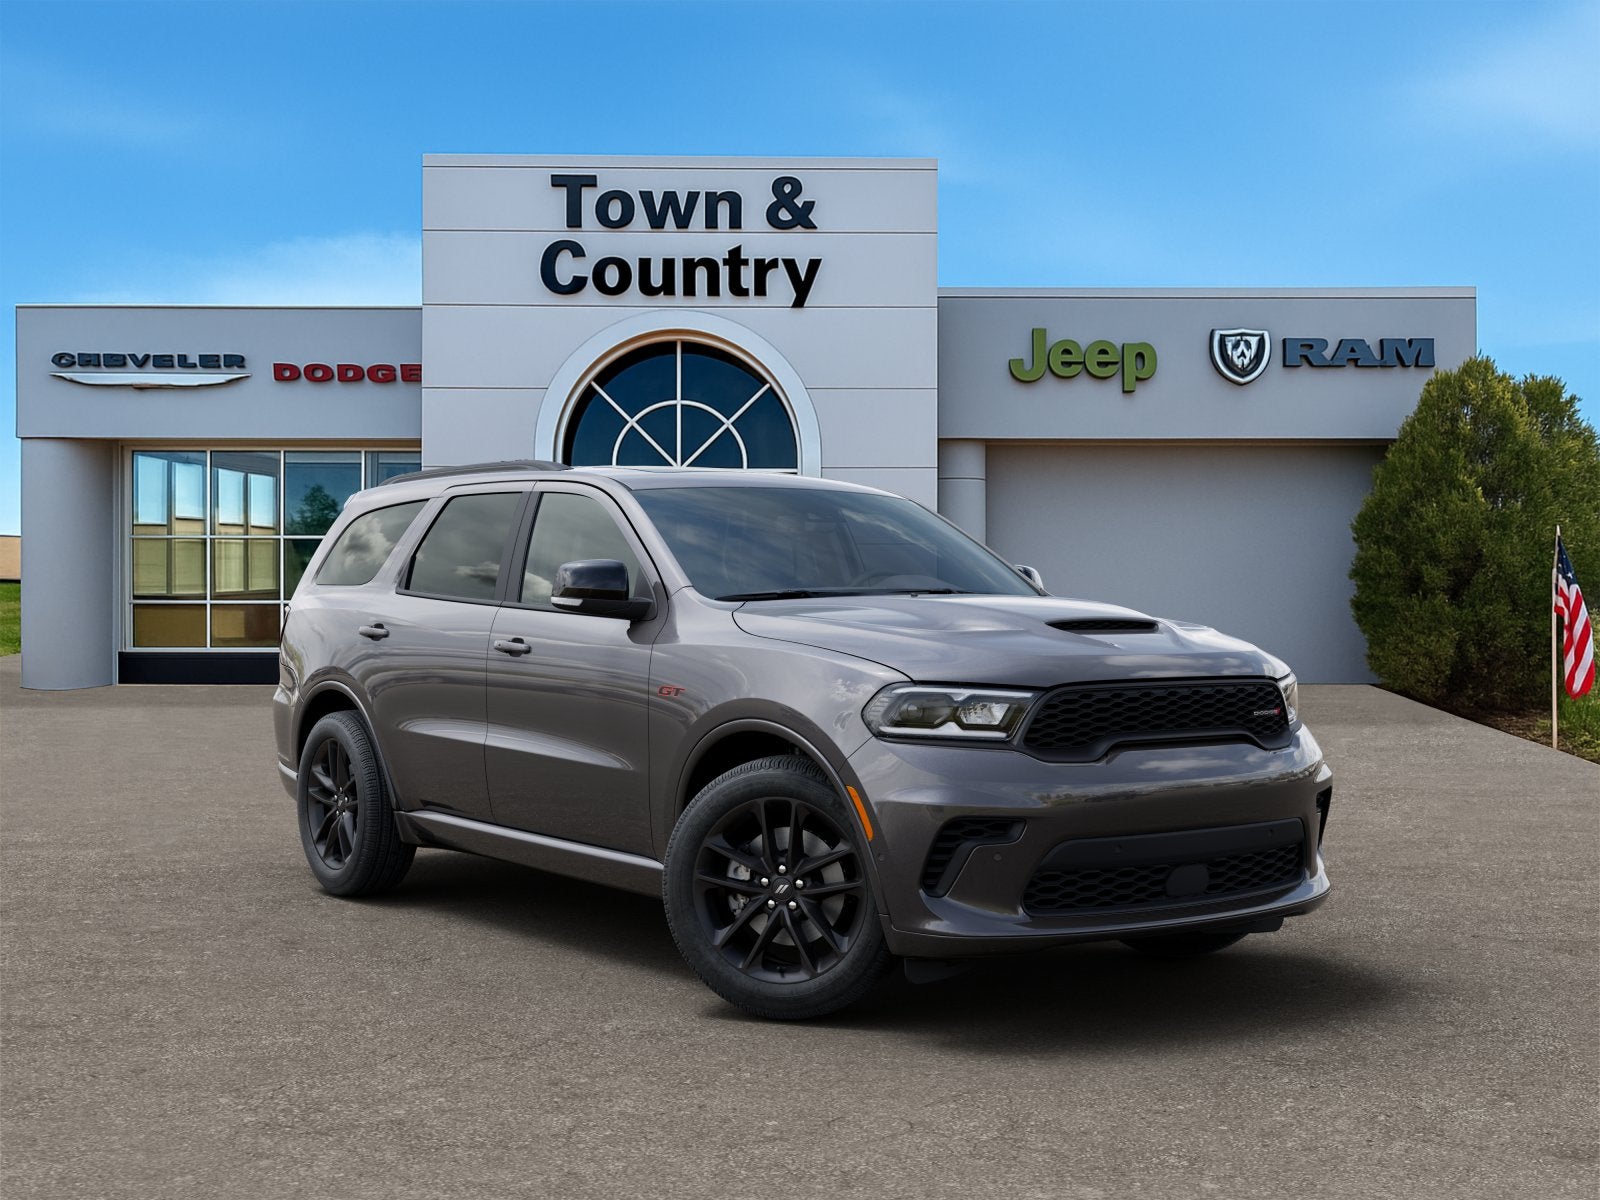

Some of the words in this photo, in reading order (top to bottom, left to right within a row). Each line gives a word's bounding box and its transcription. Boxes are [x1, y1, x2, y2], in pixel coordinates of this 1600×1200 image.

[551, 173, 743, 230] Town
[765, 175, 818, 230] &
[540, 239, 822, 308] Country
[272, 363, 422, 382] DODGE
[1009, 328, 1157, 392] Jeep
[1282, 337, 1436, 368] RAM
[658, 686, 685, 697] GT
